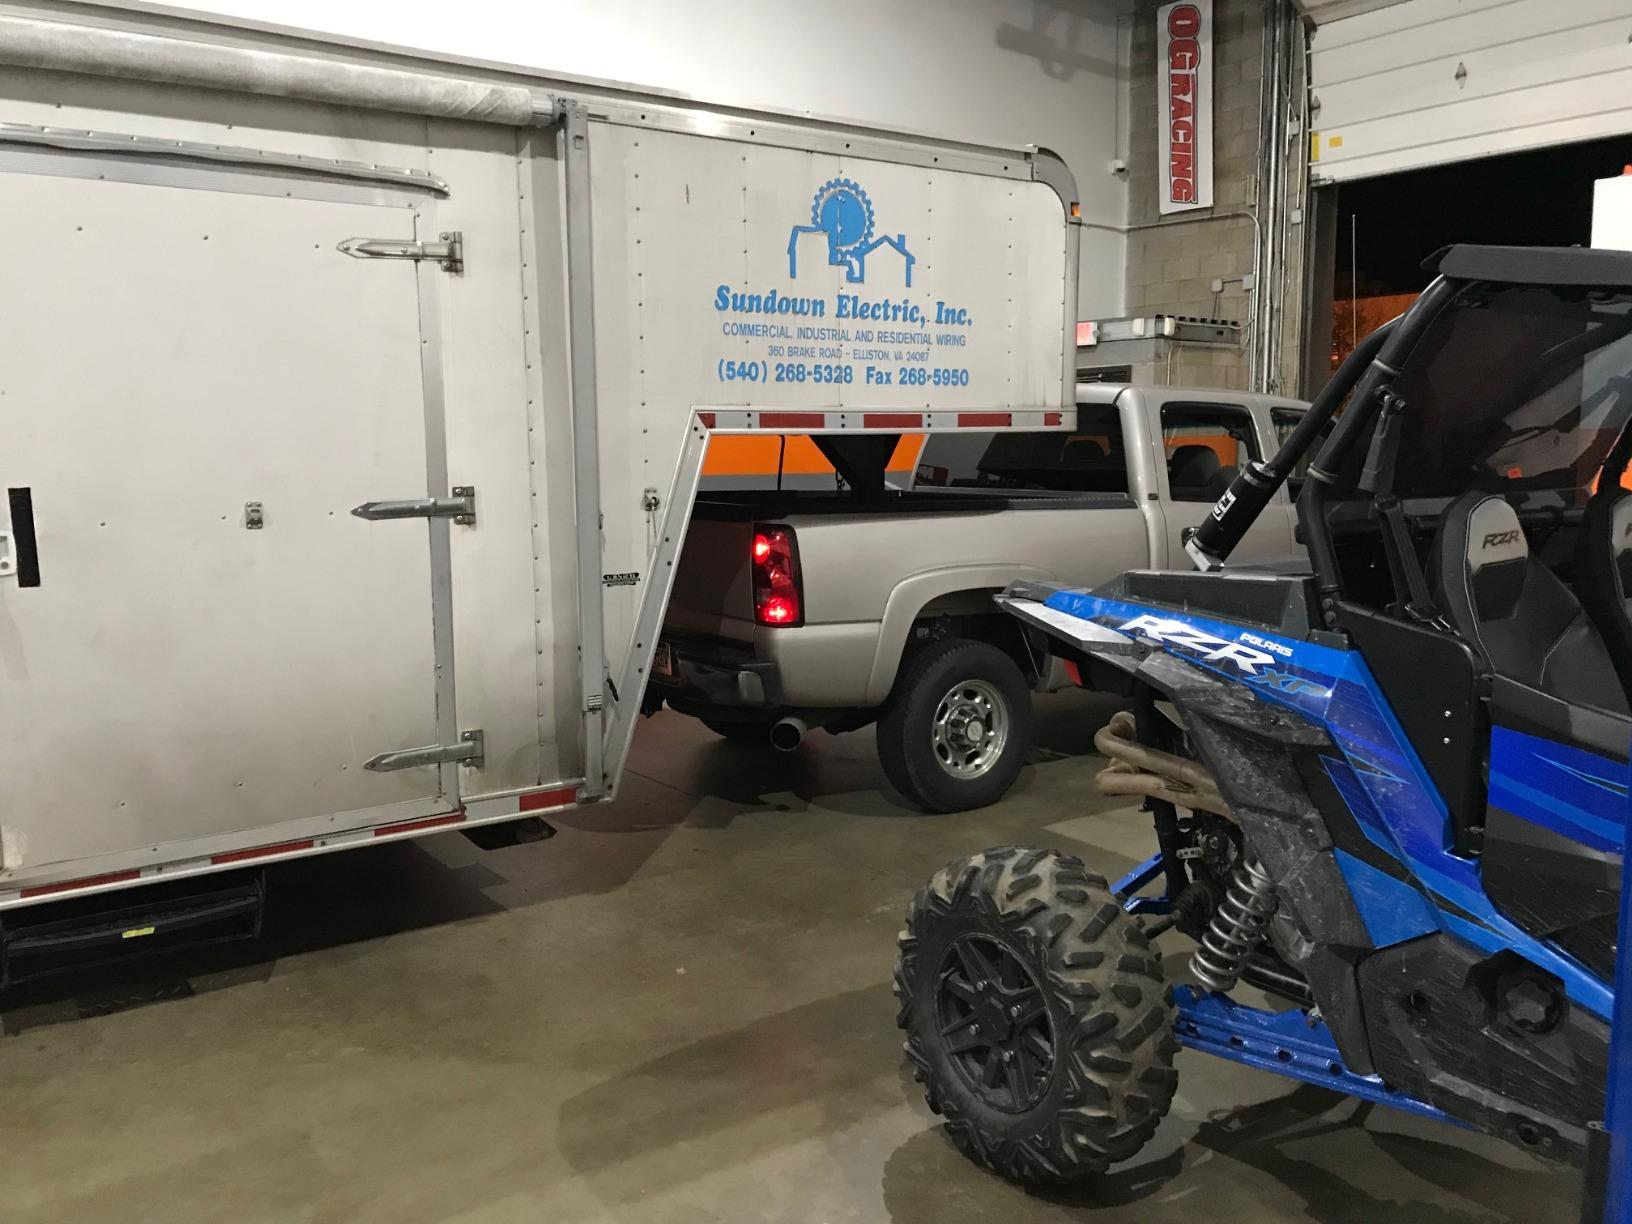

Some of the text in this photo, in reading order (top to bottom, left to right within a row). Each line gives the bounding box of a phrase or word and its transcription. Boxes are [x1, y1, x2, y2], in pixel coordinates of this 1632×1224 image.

[1168, 5, 1200, 204] OG RACING
[714, 285, 973, 328] Sundown Electric, Inc.
[796, 327, 851, 342] INDUSTRIAL
[854, 329, 873, 343] AND
[876, 331, 933, 345] RESIDENTIAL
[936, 335, 966, 348] WIRING
[767, 345, 785, 357] 360
[787, 346, 816, 359] BRAKE
[818, 348, 843, 360] ROAD
[894, 350, 904, 361] VA
[906, 350, 930, 362] 24087
[718, 358, 969, 386] (540) 268-5328 Fax 268-5950
[1117, 614, 1276, 675] RZR
[1239, 632, 1293, 657] POLARIS
[1246, 666, 1333, 698] XP
